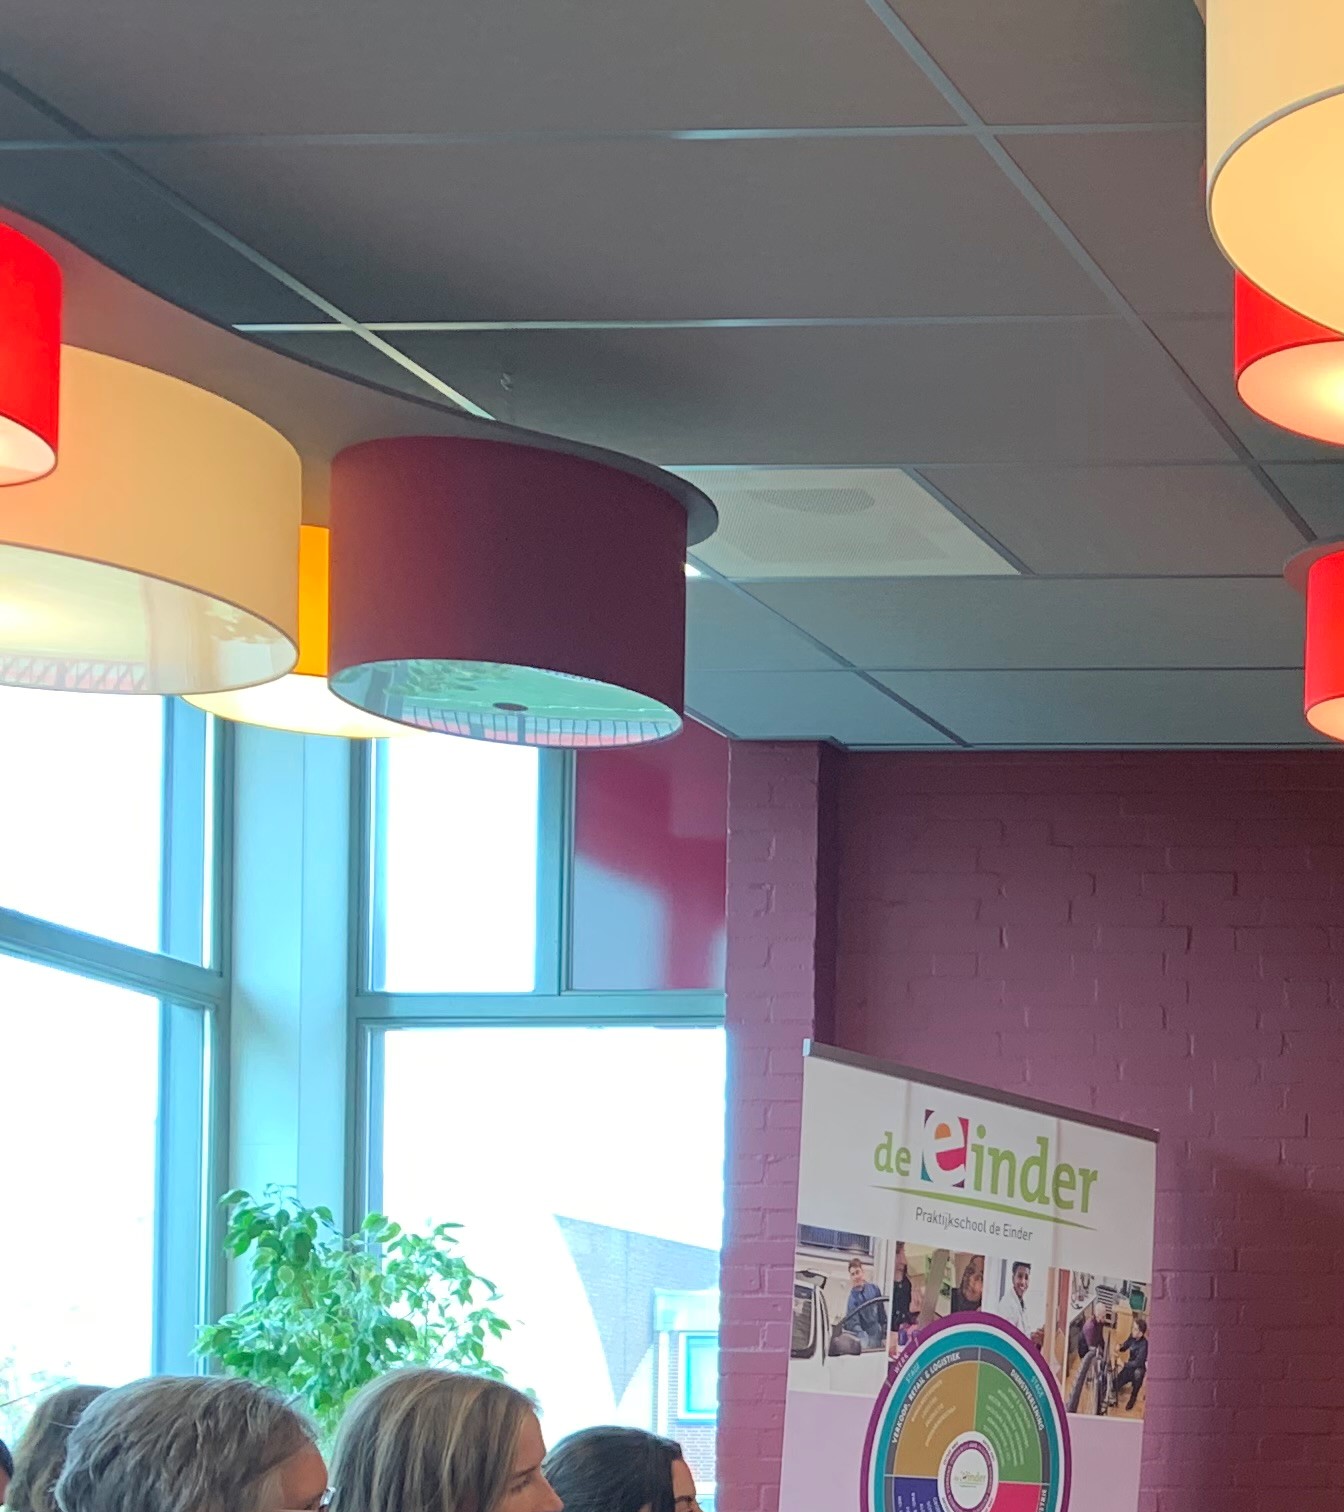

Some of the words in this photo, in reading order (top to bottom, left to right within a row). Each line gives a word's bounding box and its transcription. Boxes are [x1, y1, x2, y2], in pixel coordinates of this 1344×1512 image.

[874, 1131, 911, 1176] de
[916, 1207, 987, 1233] Praktijkschool
[989, 1221, 1001, 1235] de
[1003, 1224, 1033, 1241] Einder
